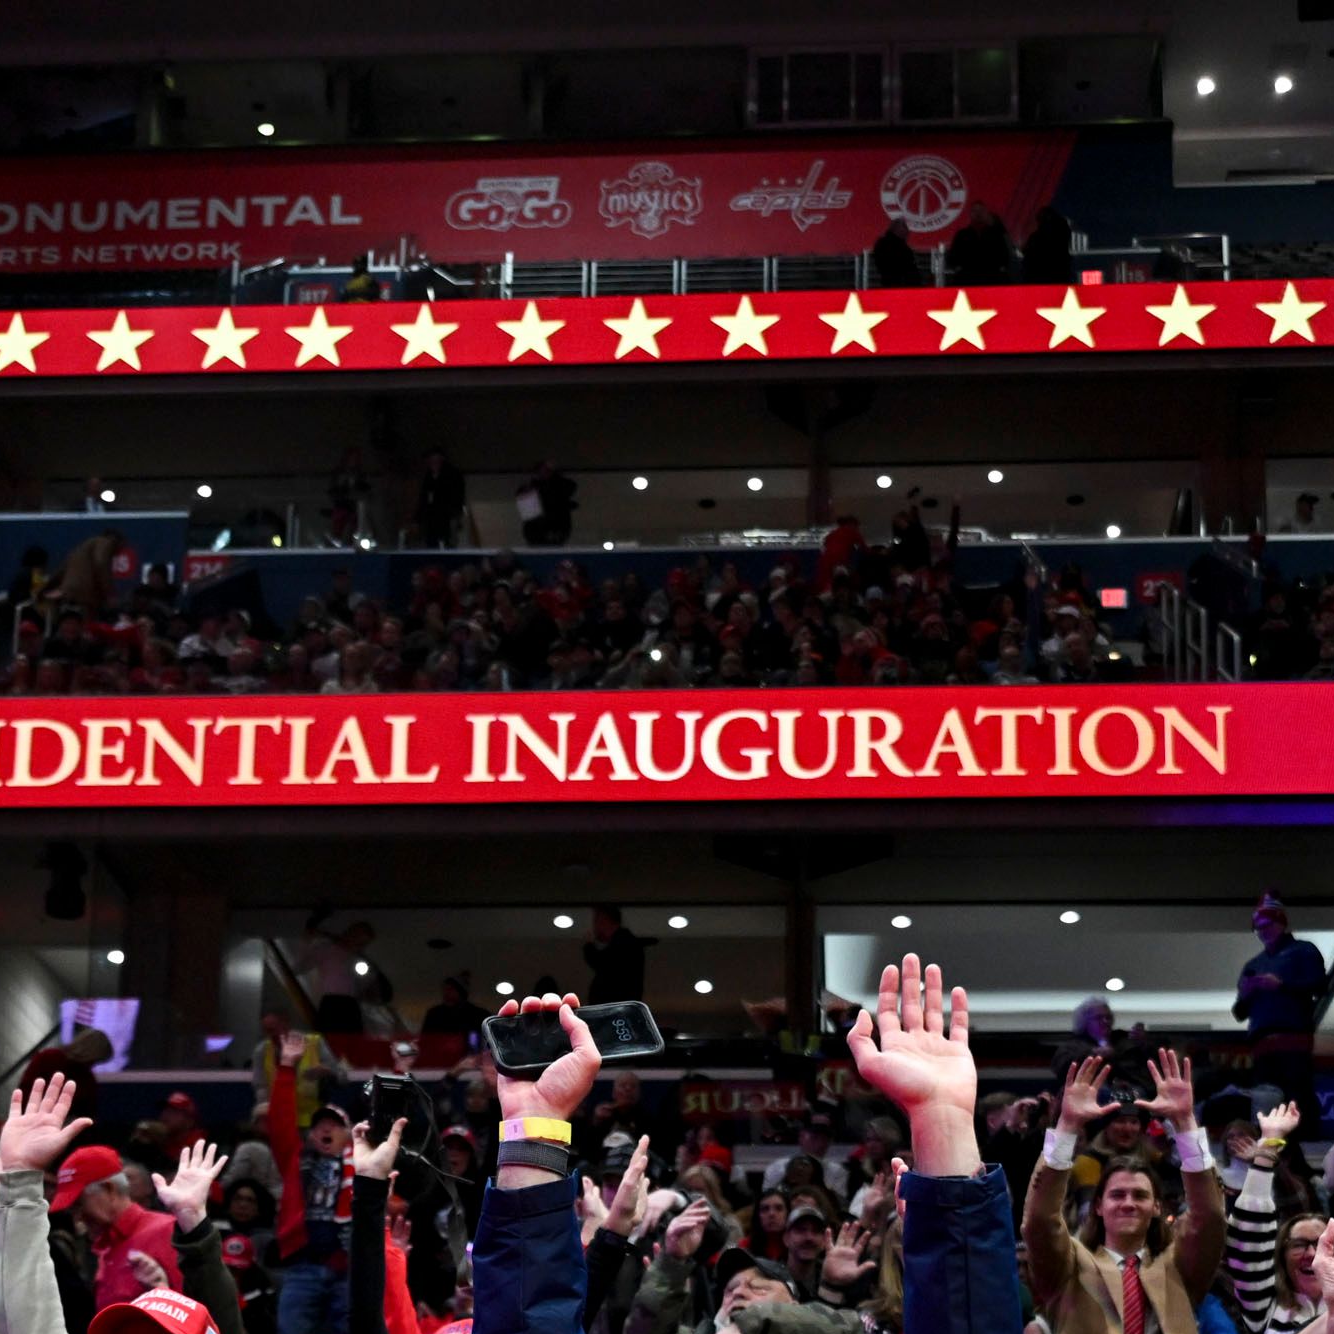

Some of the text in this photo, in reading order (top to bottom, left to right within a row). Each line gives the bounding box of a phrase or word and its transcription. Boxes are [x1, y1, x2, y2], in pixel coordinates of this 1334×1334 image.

[71, 241, 242, 264] NETWORK
[464, 705, 1233, 783] INAUGURATION
[148, 1302, 189, 1324] AGAIN
